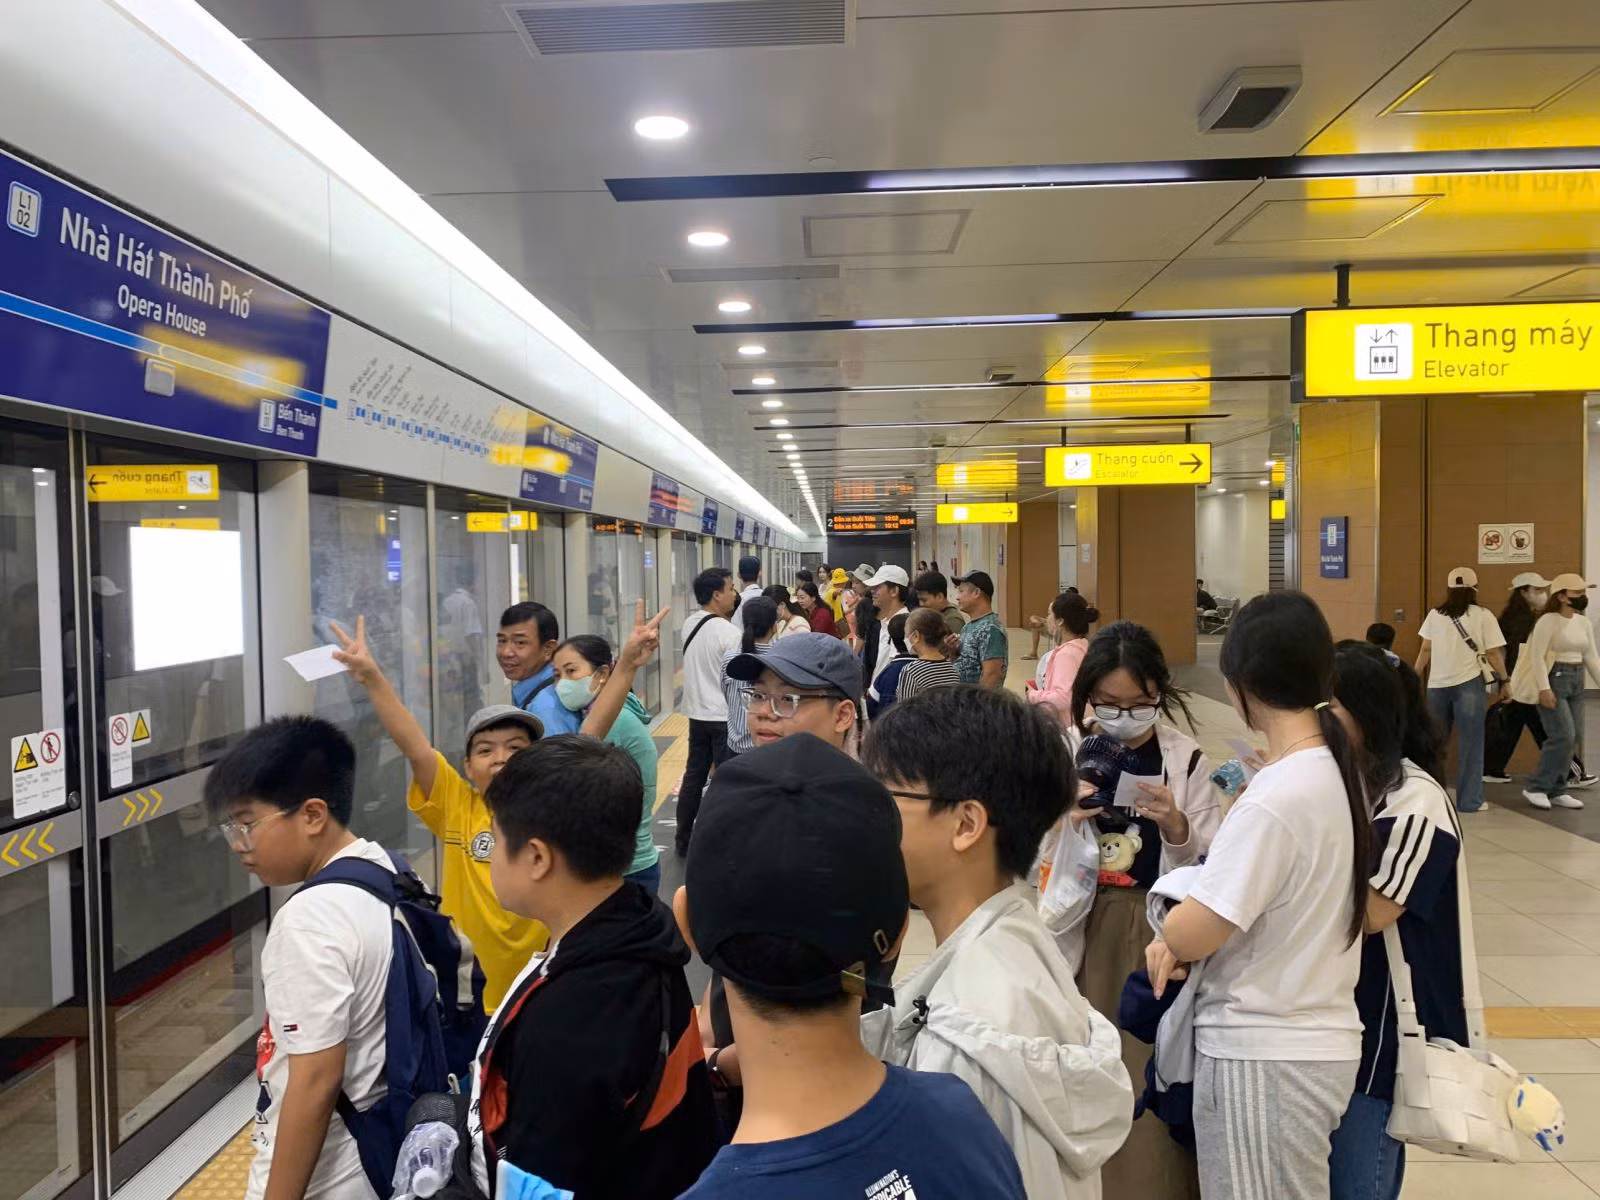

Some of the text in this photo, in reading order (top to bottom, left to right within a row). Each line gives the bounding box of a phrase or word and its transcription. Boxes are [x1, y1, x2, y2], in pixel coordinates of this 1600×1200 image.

[19, 190, 32, 211] L1
[16, 209, 31, 229] 02
[60, 206, 254, 319] Nhà Hát Thành Phố
[118, 284, 207, 337] Opera House
[1425, 318, 1593, 353] Thang máy
[1424, 360, 1510, 378] Elevator
[1096, 452, 1138, 467] Thang
[827, 519, 834, 527] 2
